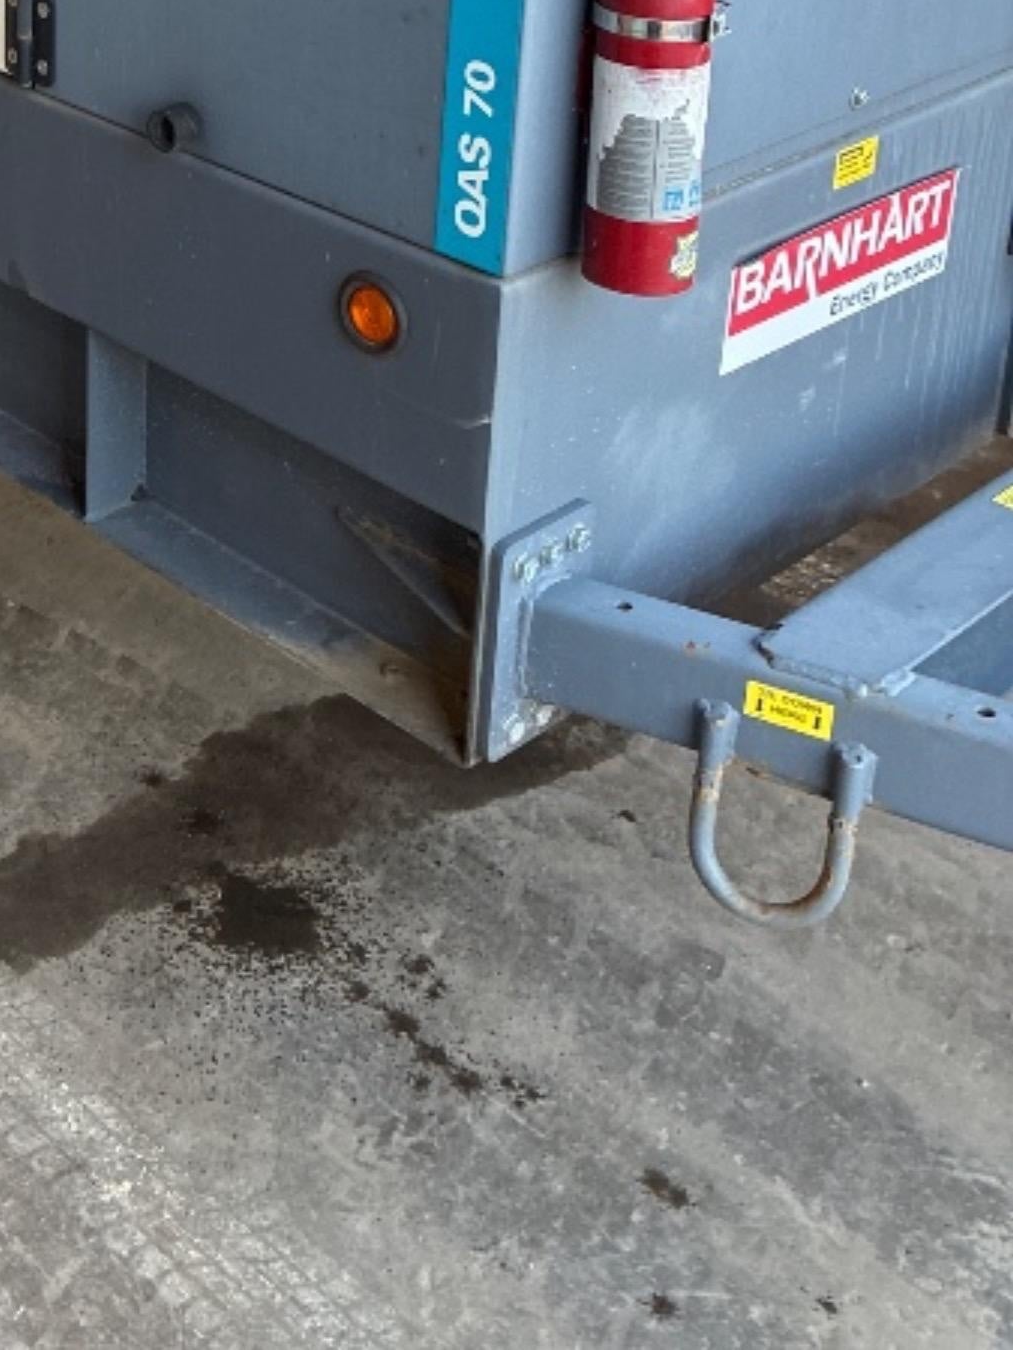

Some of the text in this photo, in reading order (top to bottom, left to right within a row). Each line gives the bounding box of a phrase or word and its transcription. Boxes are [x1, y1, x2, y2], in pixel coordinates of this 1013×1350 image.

[455, 59, 496, 238] QAS 70
[735, 180, 951, 315] BARNHART
[830, 251, 944, 316] Energy Company
